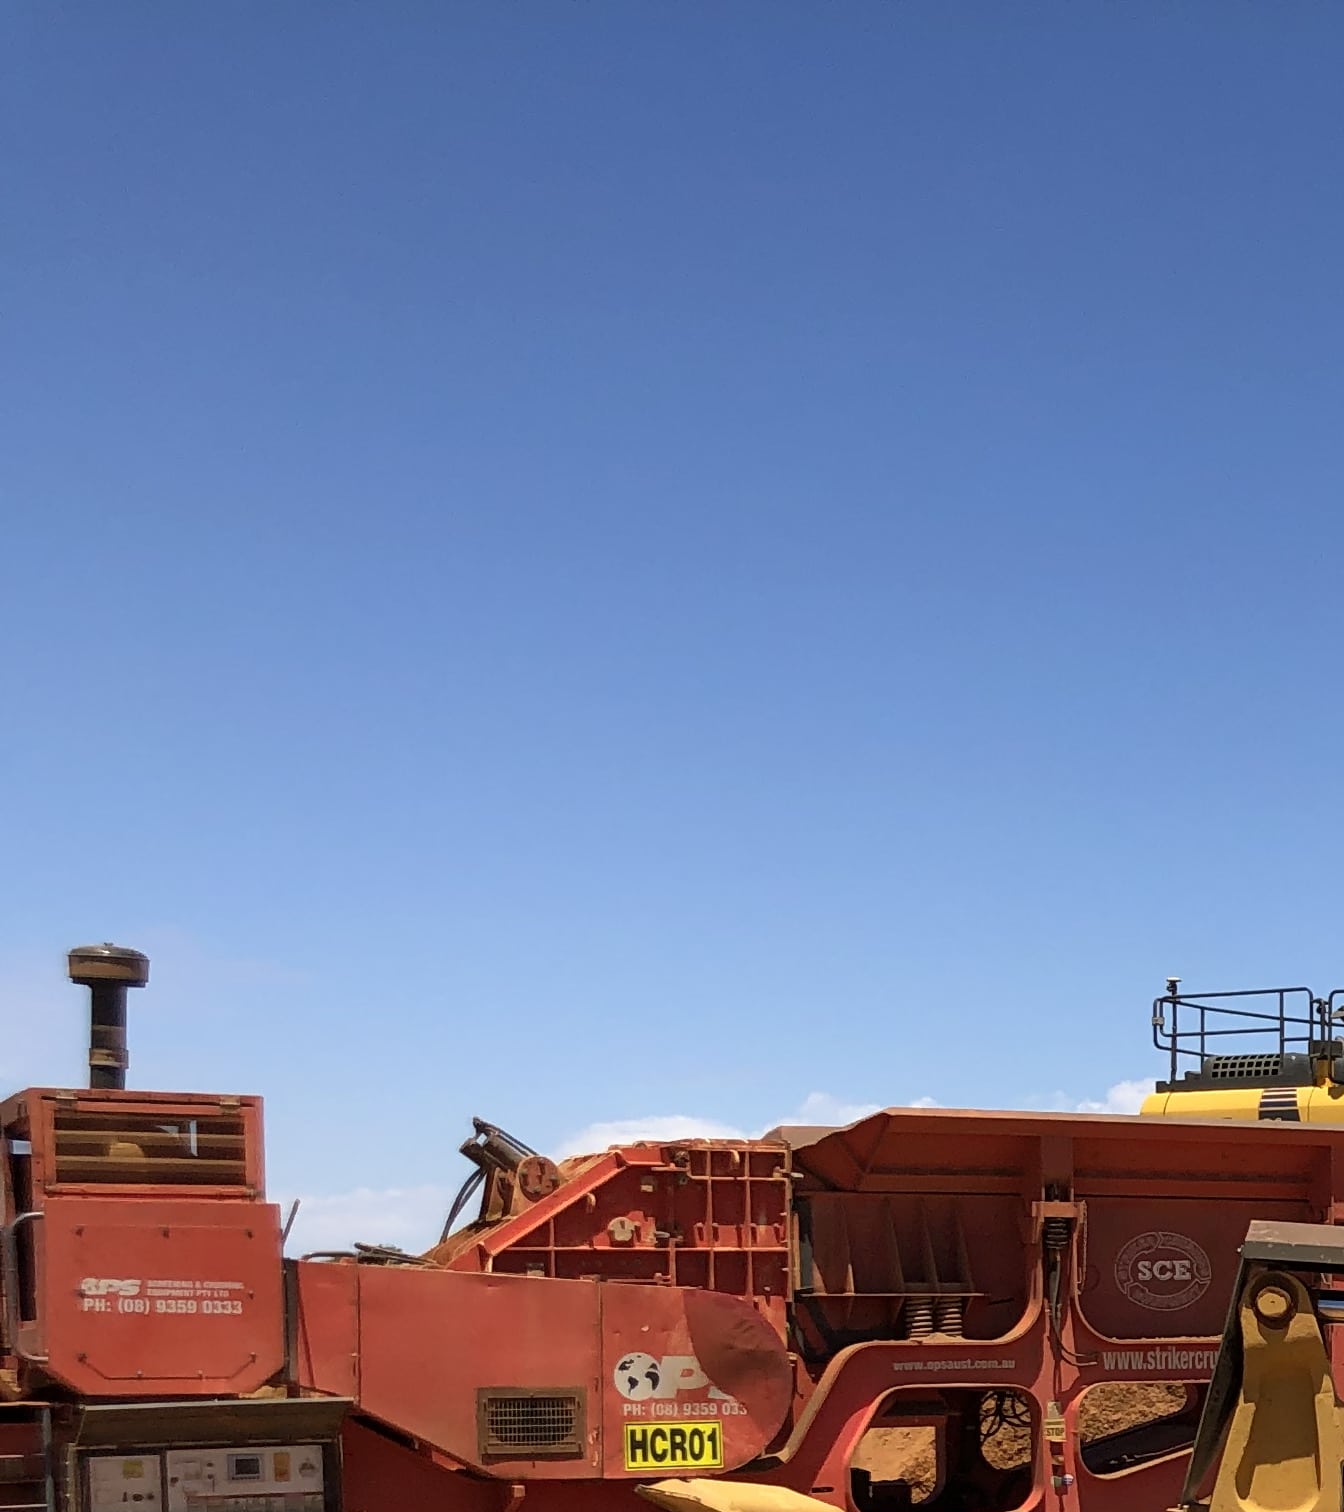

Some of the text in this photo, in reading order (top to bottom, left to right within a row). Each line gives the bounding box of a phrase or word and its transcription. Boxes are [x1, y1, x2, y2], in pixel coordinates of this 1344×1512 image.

[1137, 1260, 1192, 1281] SCE
[82, 1298, 243, 1315] PH: (08) 9359 0333
[893, 1358, 1016, 1372] www.opsaust.com.au
[614, 1352, 738, 1402] OP
[623, 1403, 646, 1416] PH:
[651, 1403, 678, 1416] (08)
[683, 1403, 718, 1416] 9359
[1046, 1427, 1065, 1436] STOP
[629, 1427, 718, 1463] HCR01
